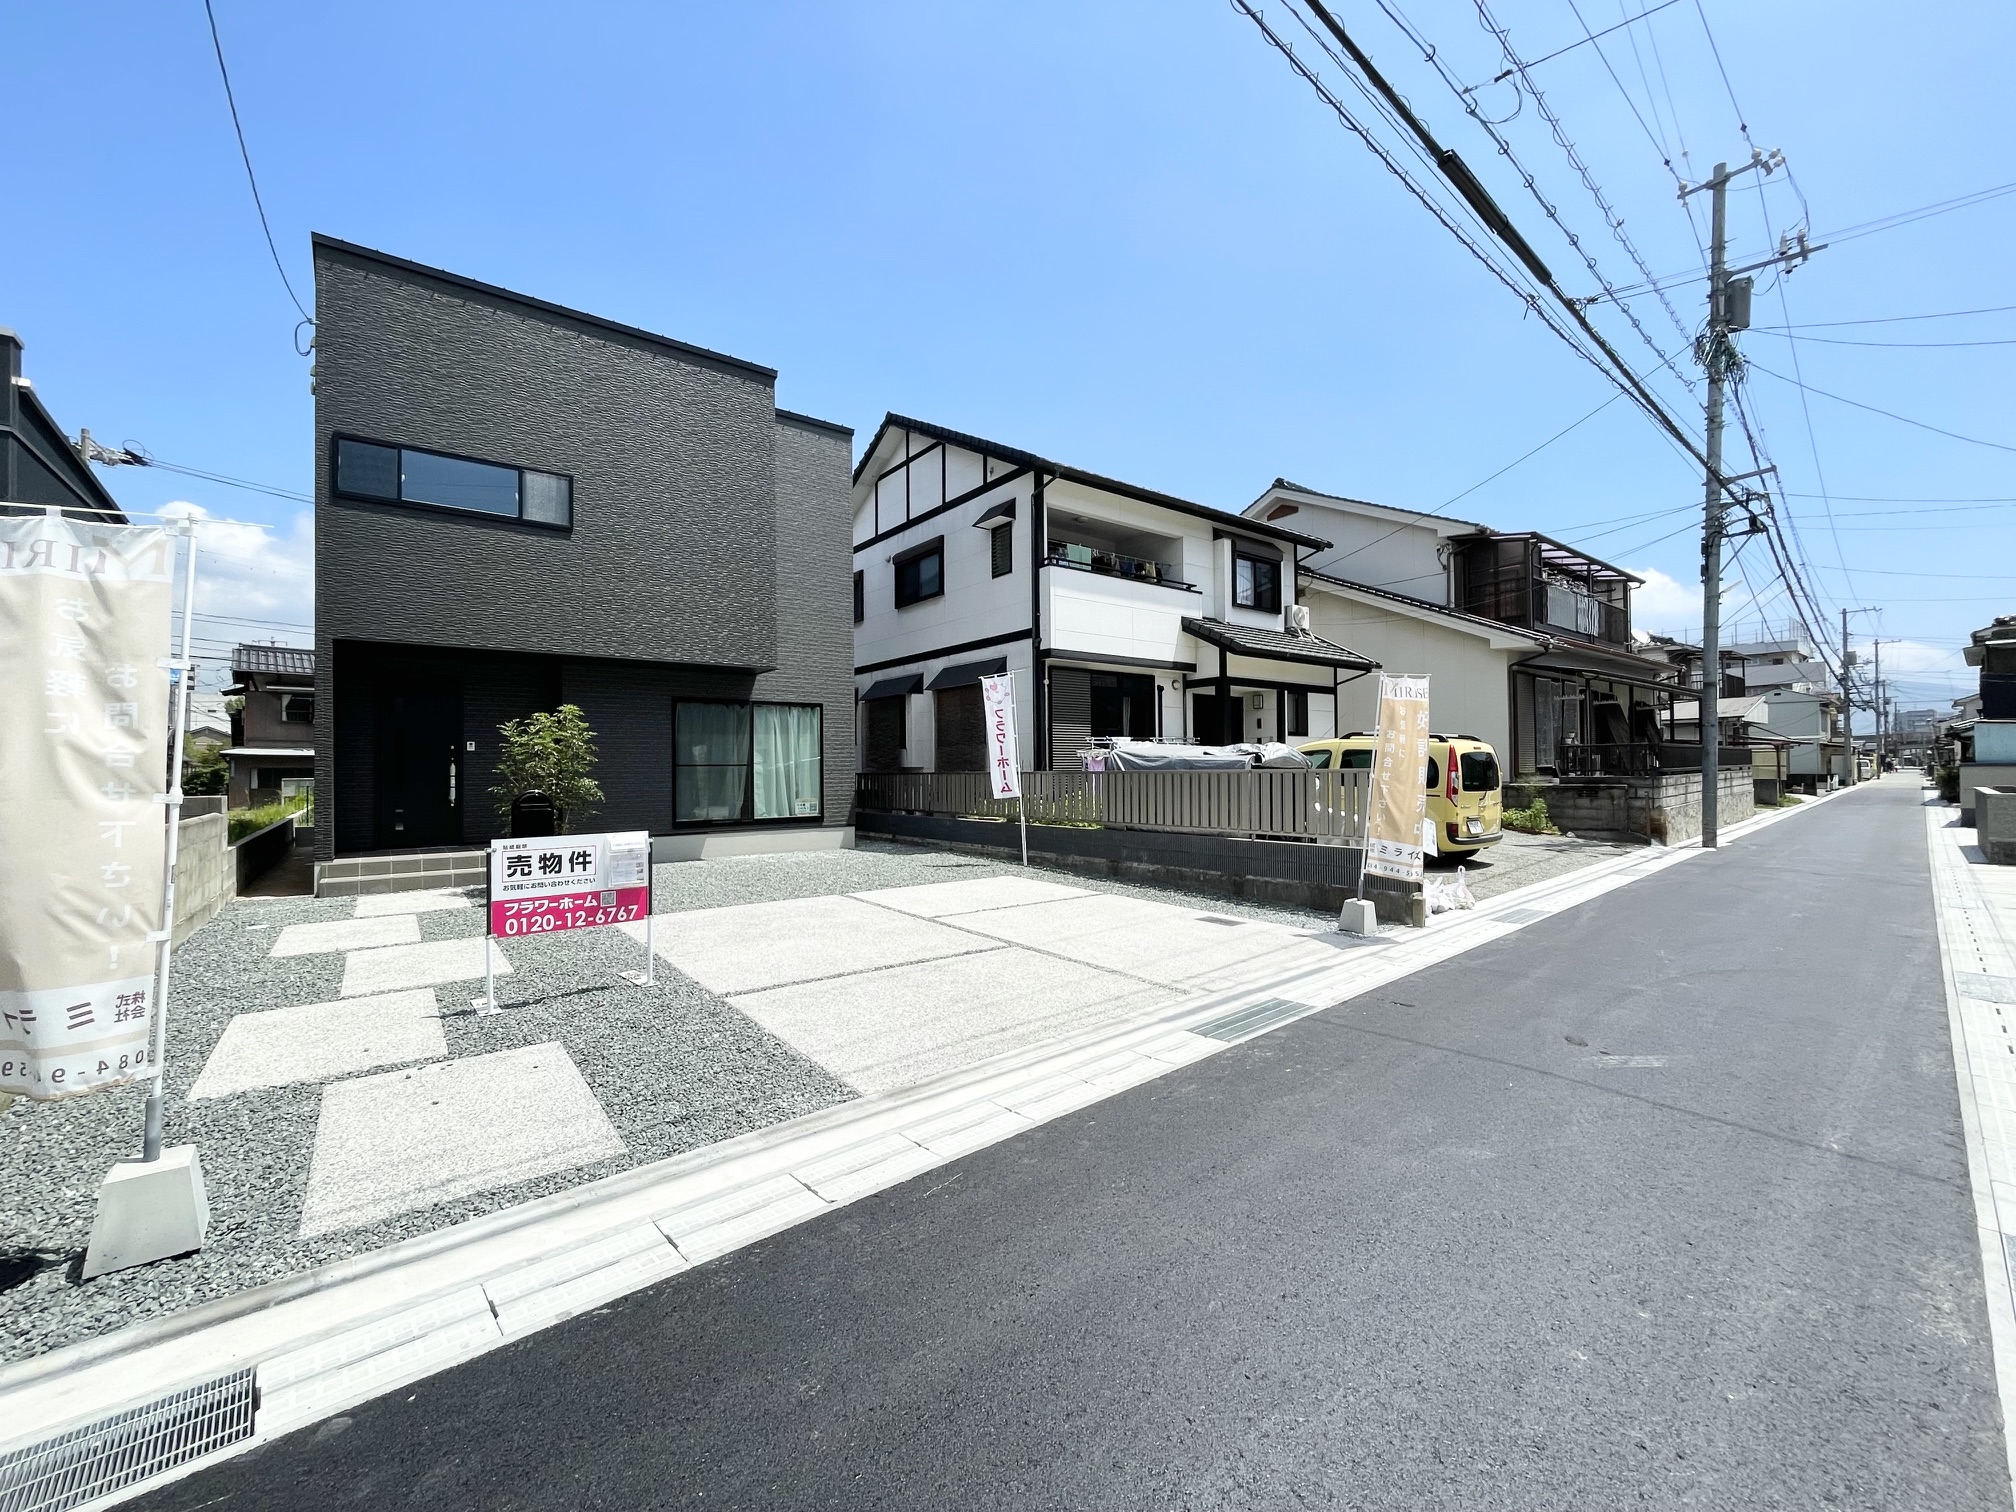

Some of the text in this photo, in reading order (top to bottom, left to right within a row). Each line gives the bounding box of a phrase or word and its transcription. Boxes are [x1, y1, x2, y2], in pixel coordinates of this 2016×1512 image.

[506, 850, 593, 878] 売物件
[502, 877, 596, 892] お気軽にお問い合わせください
[504, 895, 598, 915] フラワーホーム
[505, 905, 639, 935] 0120-12-6767
